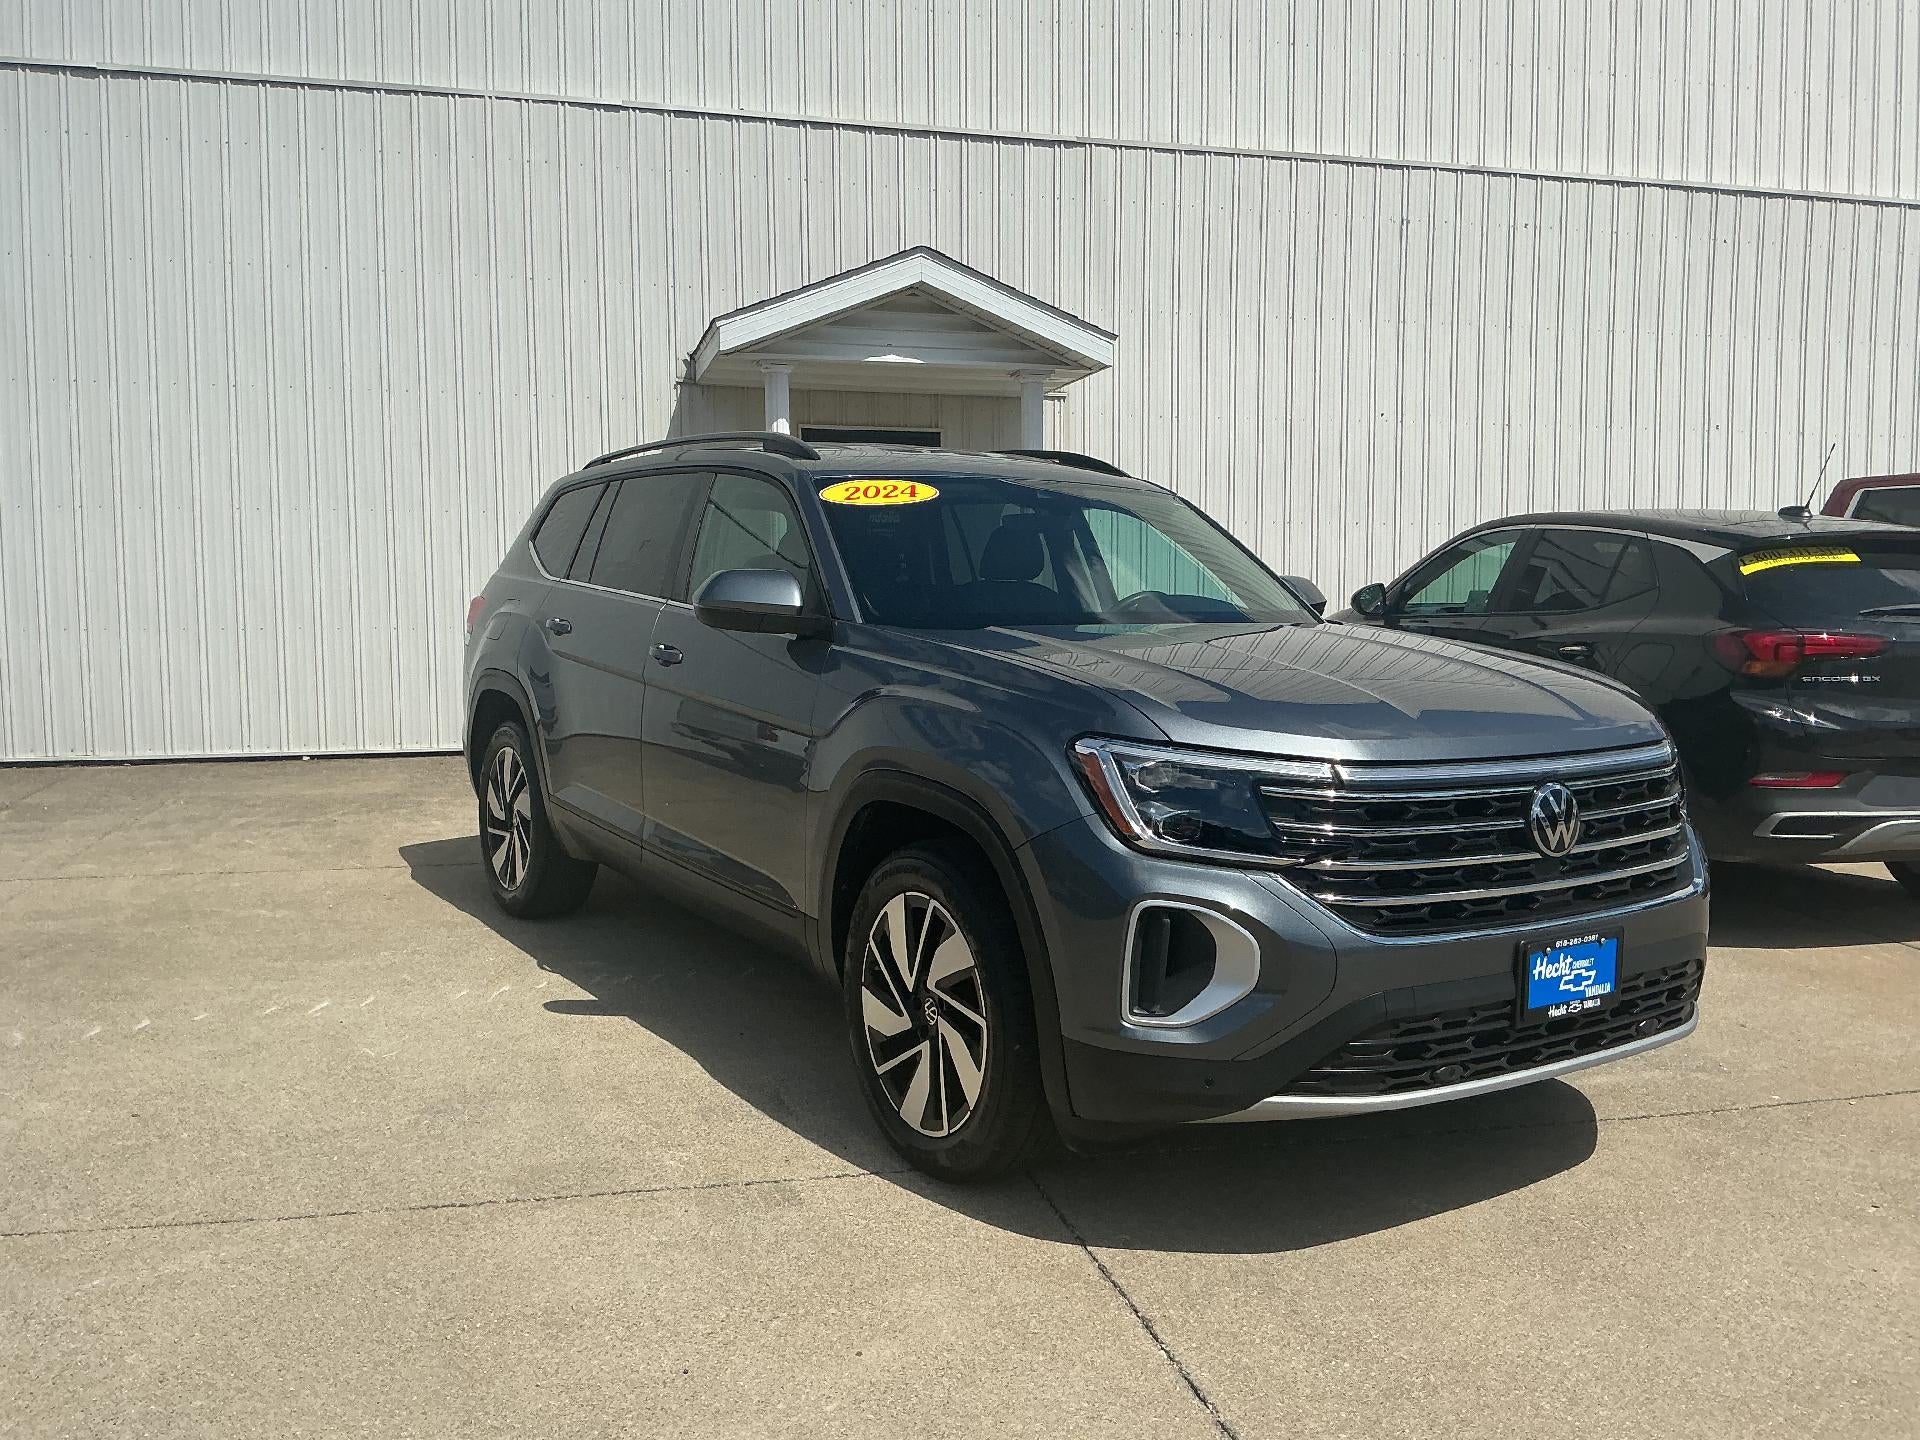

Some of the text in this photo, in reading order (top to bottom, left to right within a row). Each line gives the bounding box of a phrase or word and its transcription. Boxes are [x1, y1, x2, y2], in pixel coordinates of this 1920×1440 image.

[844, 484, 920, 501] 2024
[1532, 952, 1573, 980] Hecht
[1548, 1004, 1567, 1017] Hecht
